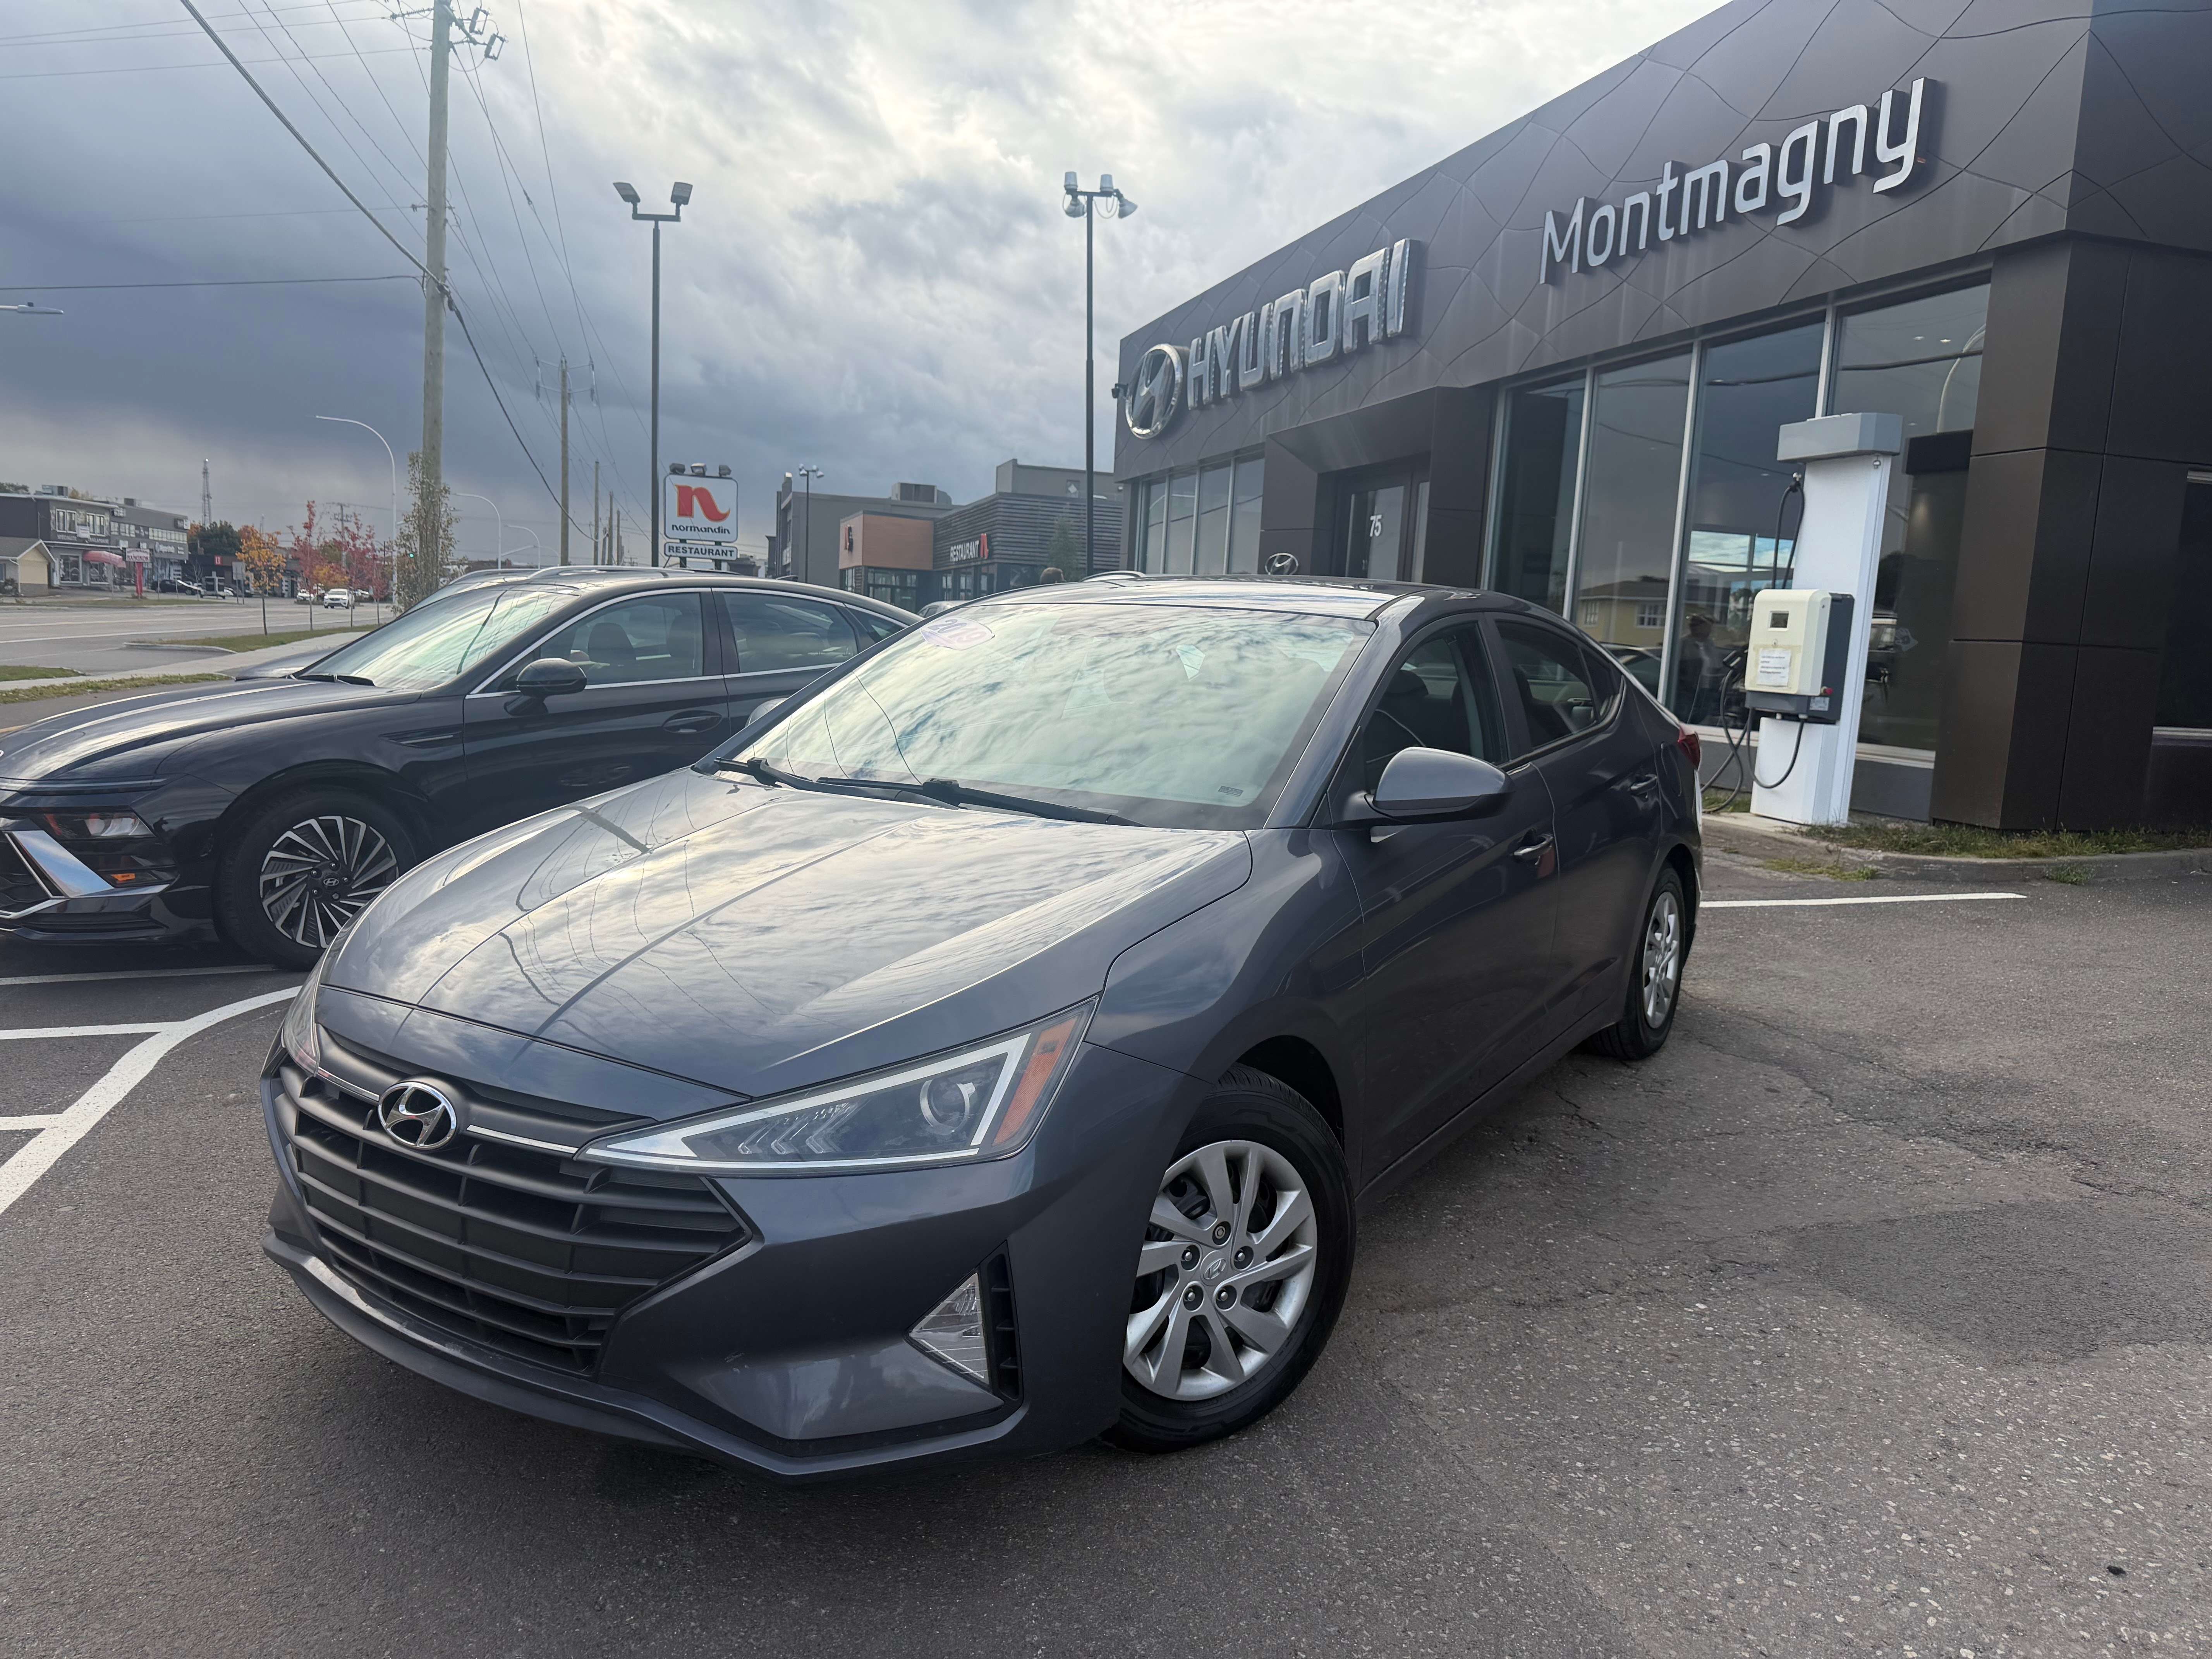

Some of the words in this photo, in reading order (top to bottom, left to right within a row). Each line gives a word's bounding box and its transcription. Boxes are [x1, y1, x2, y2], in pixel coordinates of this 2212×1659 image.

[1539, 77, 1926, 284] Montmagny
[1186, 238, 1412, 410] HYUNDAI
[672, 524, 730, 534] normandin
[1369, 514, 1382, 537] 75
[668, 545, 735, 557] RESTAURANT
[950, 539, 979, 562] RESTAURANT
[927, 619, 987, 644] 2019
